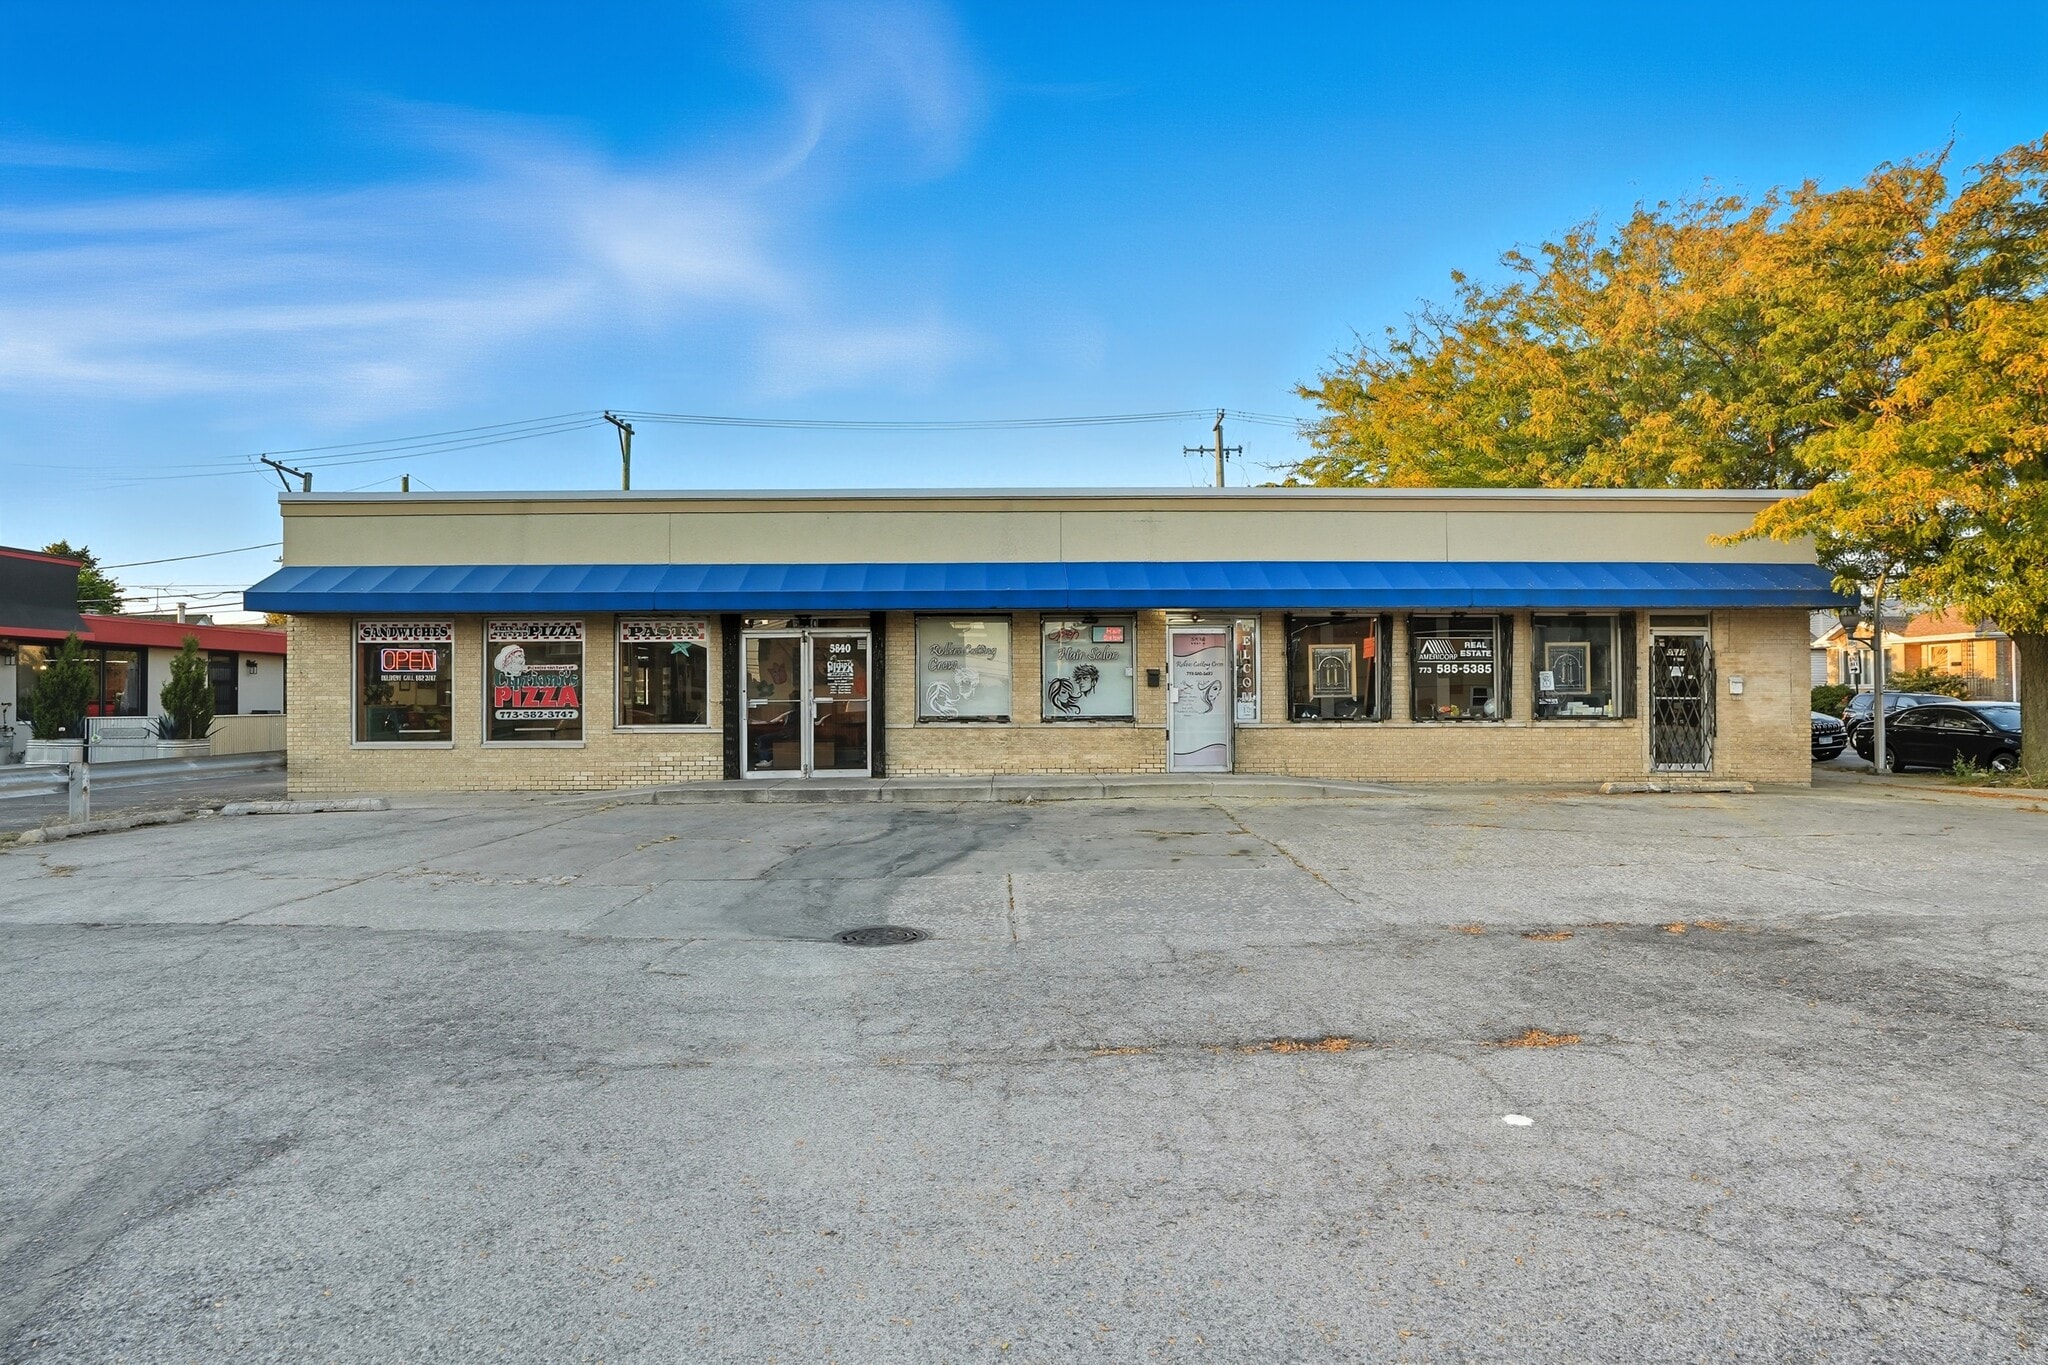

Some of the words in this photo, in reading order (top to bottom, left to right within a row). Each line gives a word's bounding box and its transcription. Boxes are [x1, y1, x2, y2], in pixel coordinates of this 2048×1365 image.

[363, 627, 448, 637] SANDWICHES
[528, 625, 578, 637] PIZZA
[628, 626, 700, 637] PASTA
[829, 643, 851, 653] 5840
[1464, 641, 1487, 649] REAL
[1057, 646, 1085, 661] Hair
[1087, 644, 1120, 661] Salon
[383, 650, 436, 671] OPEN
[1436, 664, 1492, 674] 585-5385
[494, 686, 580, 708] PIZZA
[499, 710, 575, 719] 773-582-3747
